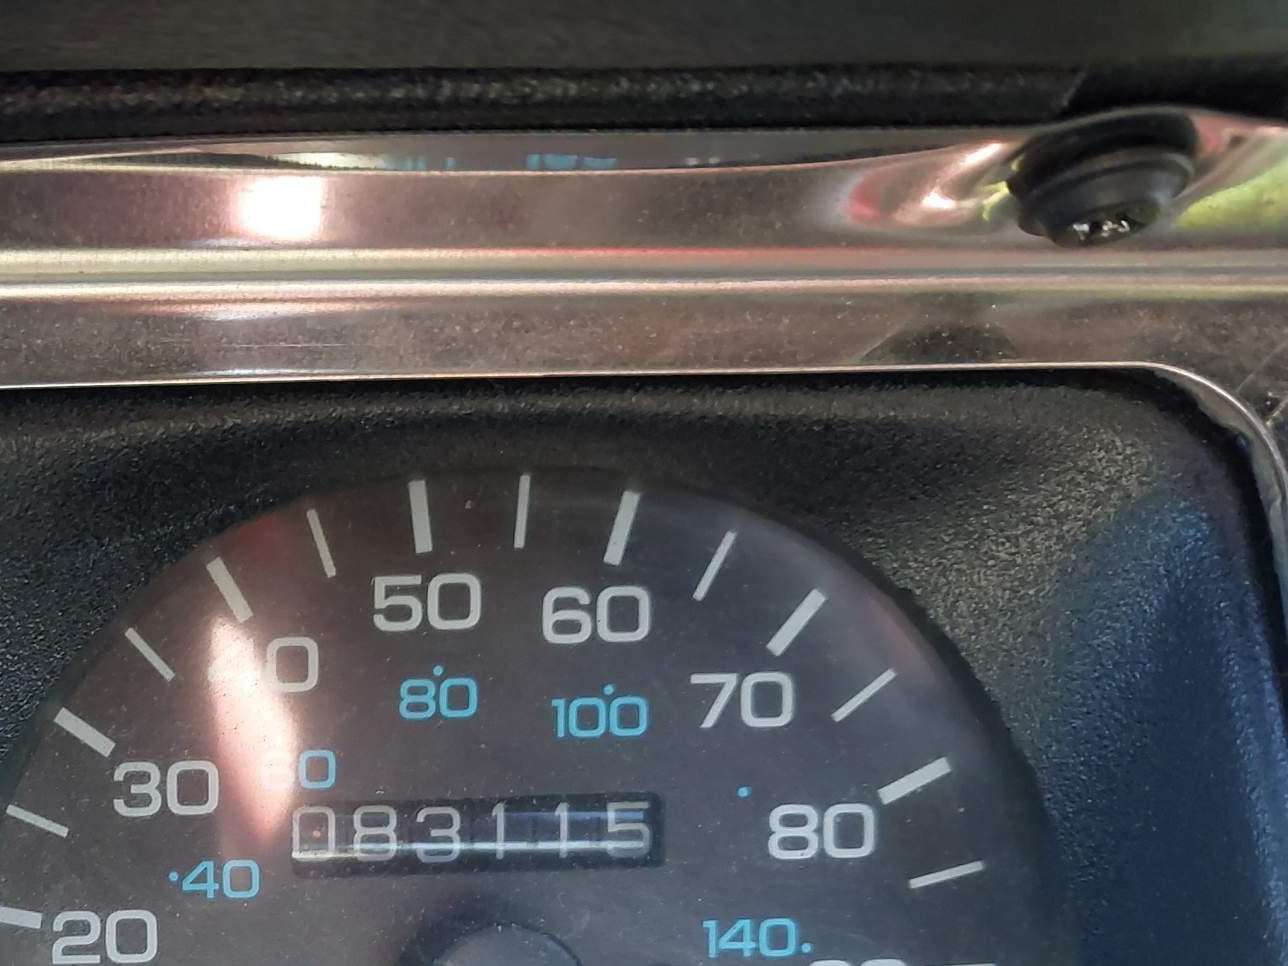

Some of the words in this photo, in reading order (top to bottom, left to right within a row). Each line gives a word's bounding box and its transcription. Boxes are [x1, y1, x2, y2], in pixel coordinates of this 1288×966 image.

[373, 572, 481, 632] 50
[542, 585, 651, 644] 60
[399, 677, 479, 720] 80
[551, 695, 649, 738] 100
[690, 671, 794, 729] 70
[113, 760, 220, 817] 30
[291, 800, 651, 863] 083115
[768, 803, 876, 859] 80
[181, 859, 261, 899] 40
[52, 909, 158, 965] 20
[702, 917, 796, 959] 140
